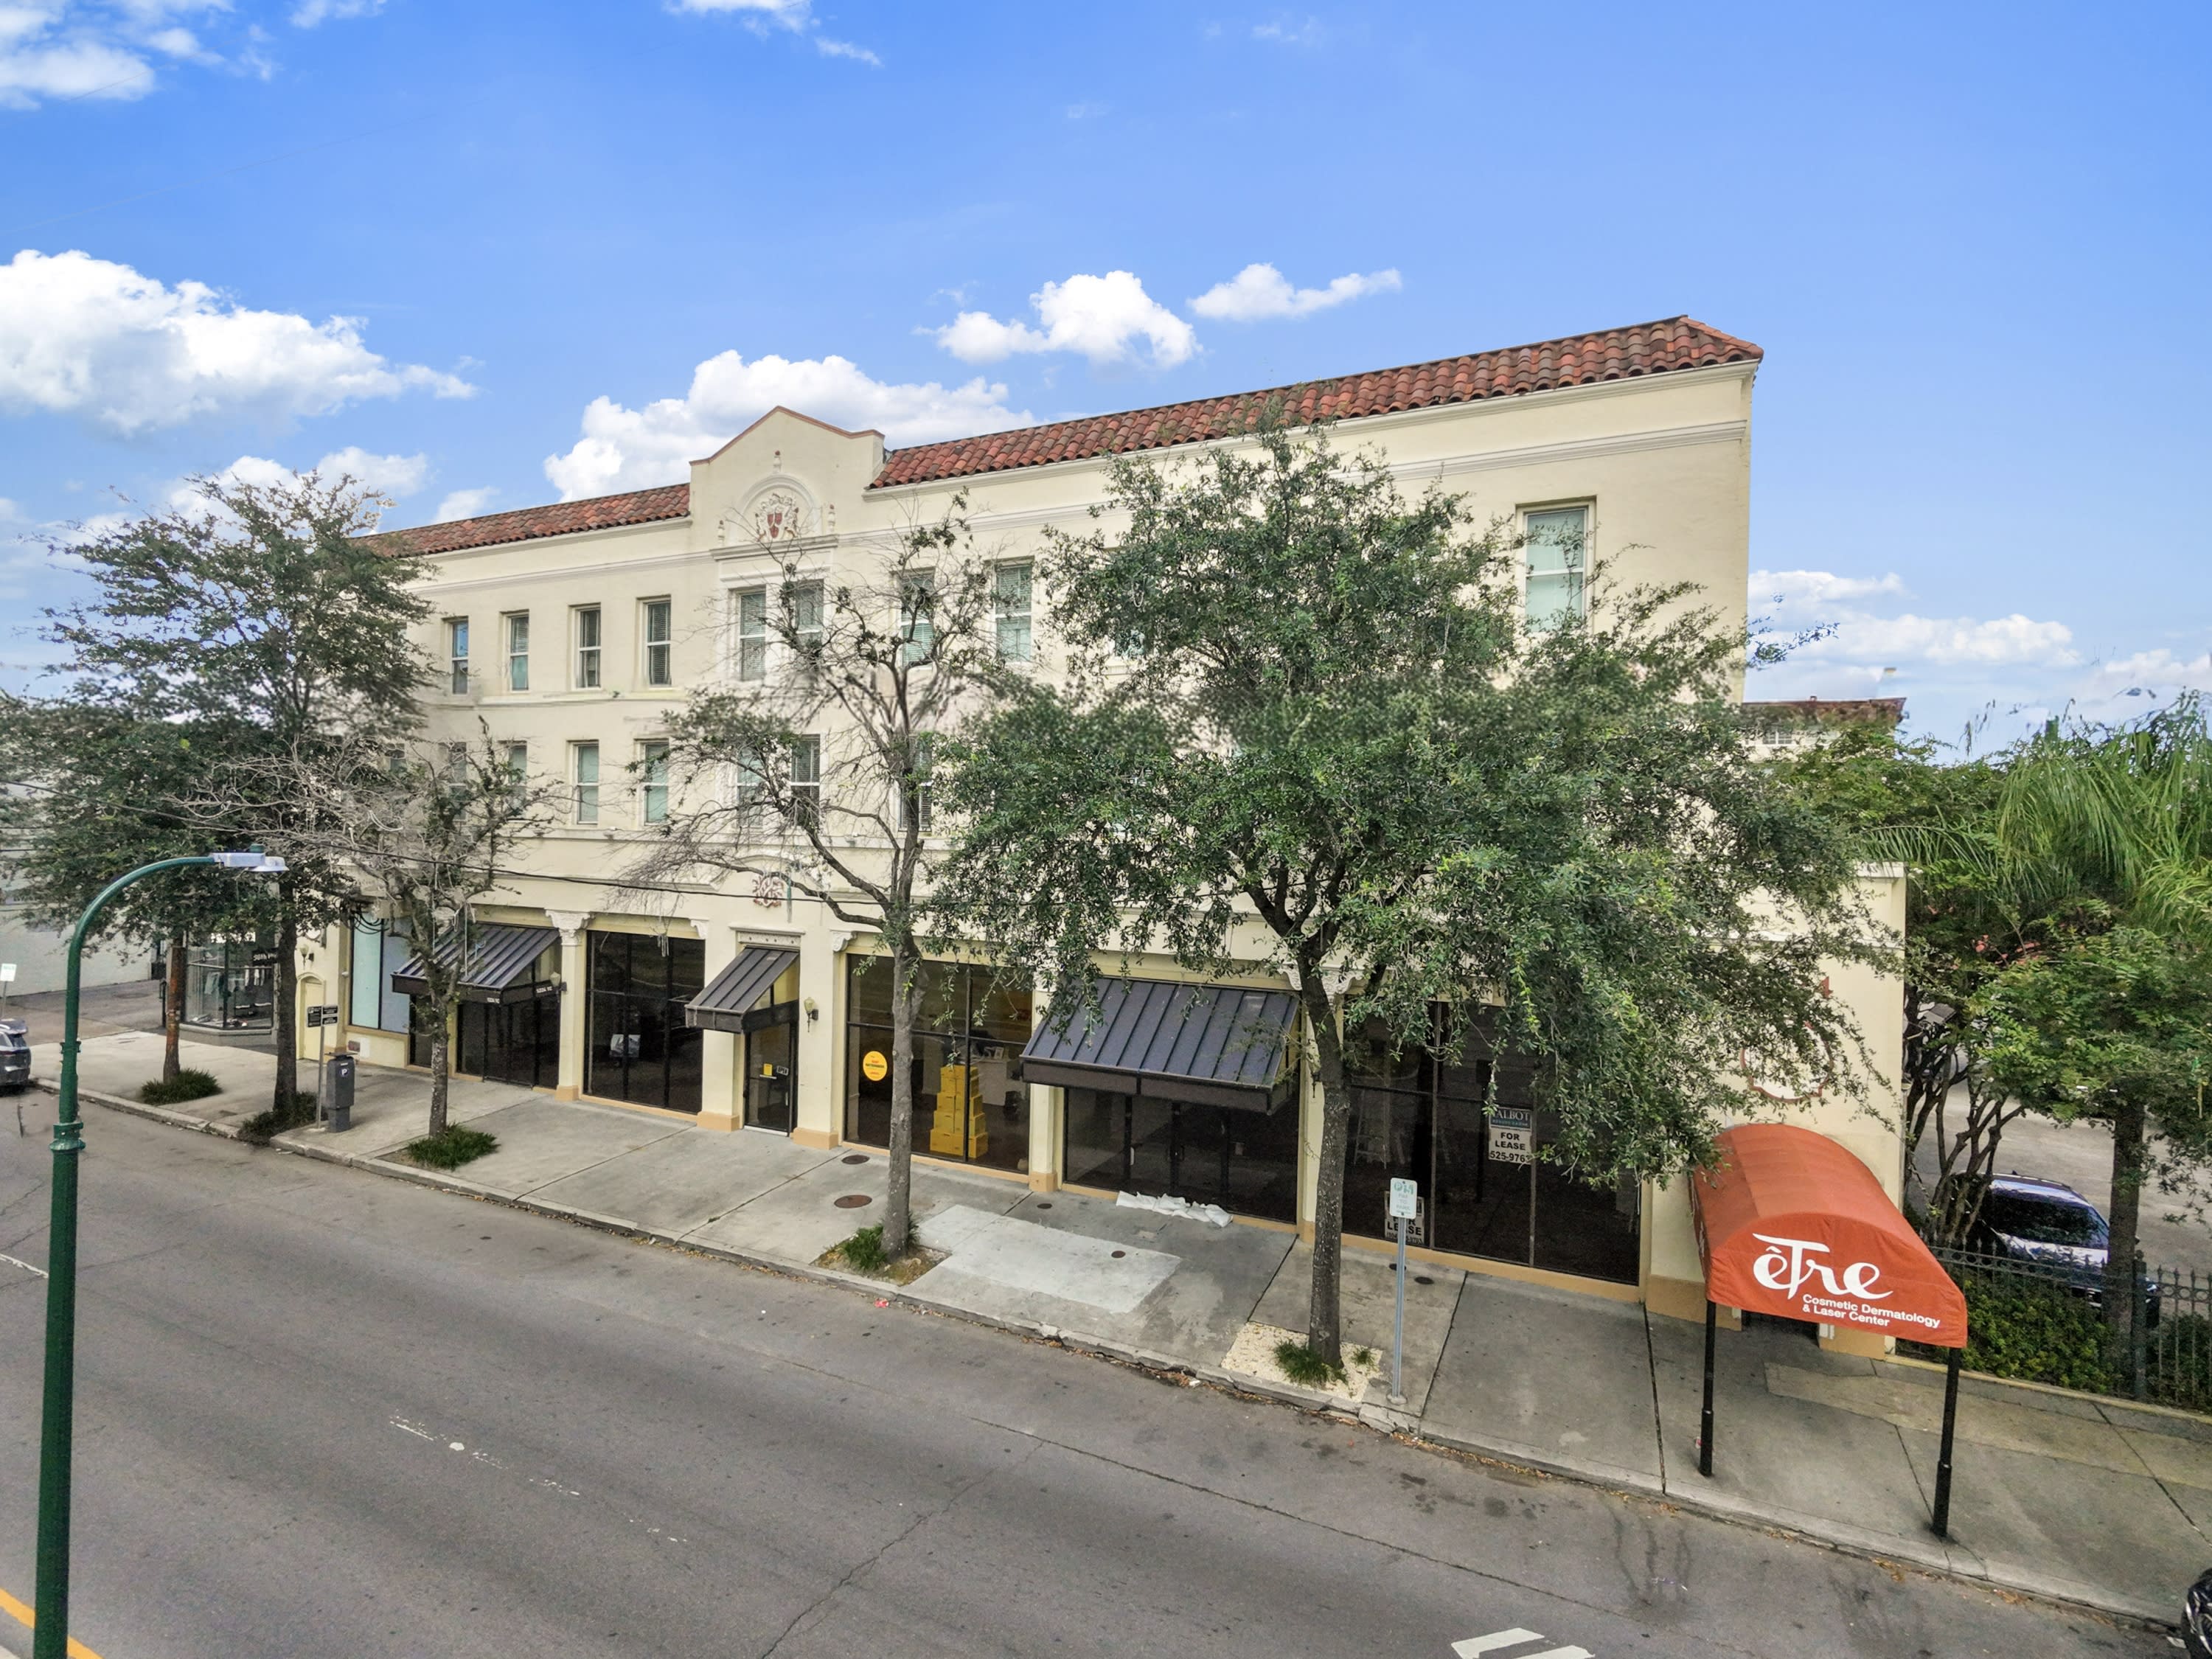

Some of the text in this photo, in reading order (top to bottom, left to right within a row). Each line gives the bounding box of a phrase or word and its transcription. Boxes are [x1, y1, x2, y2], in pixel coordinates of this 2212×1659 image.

[1500, 1132, 1520, 1141] FOR
[1495, 1140, 1526, 1150] LEASE
[1387, 1221, 1422, 1236] LESE
[1802, 1294, 1941, 1329] Cosmetic Dermatology
[1802, 1304, 1890, 1327] & Laser Center
